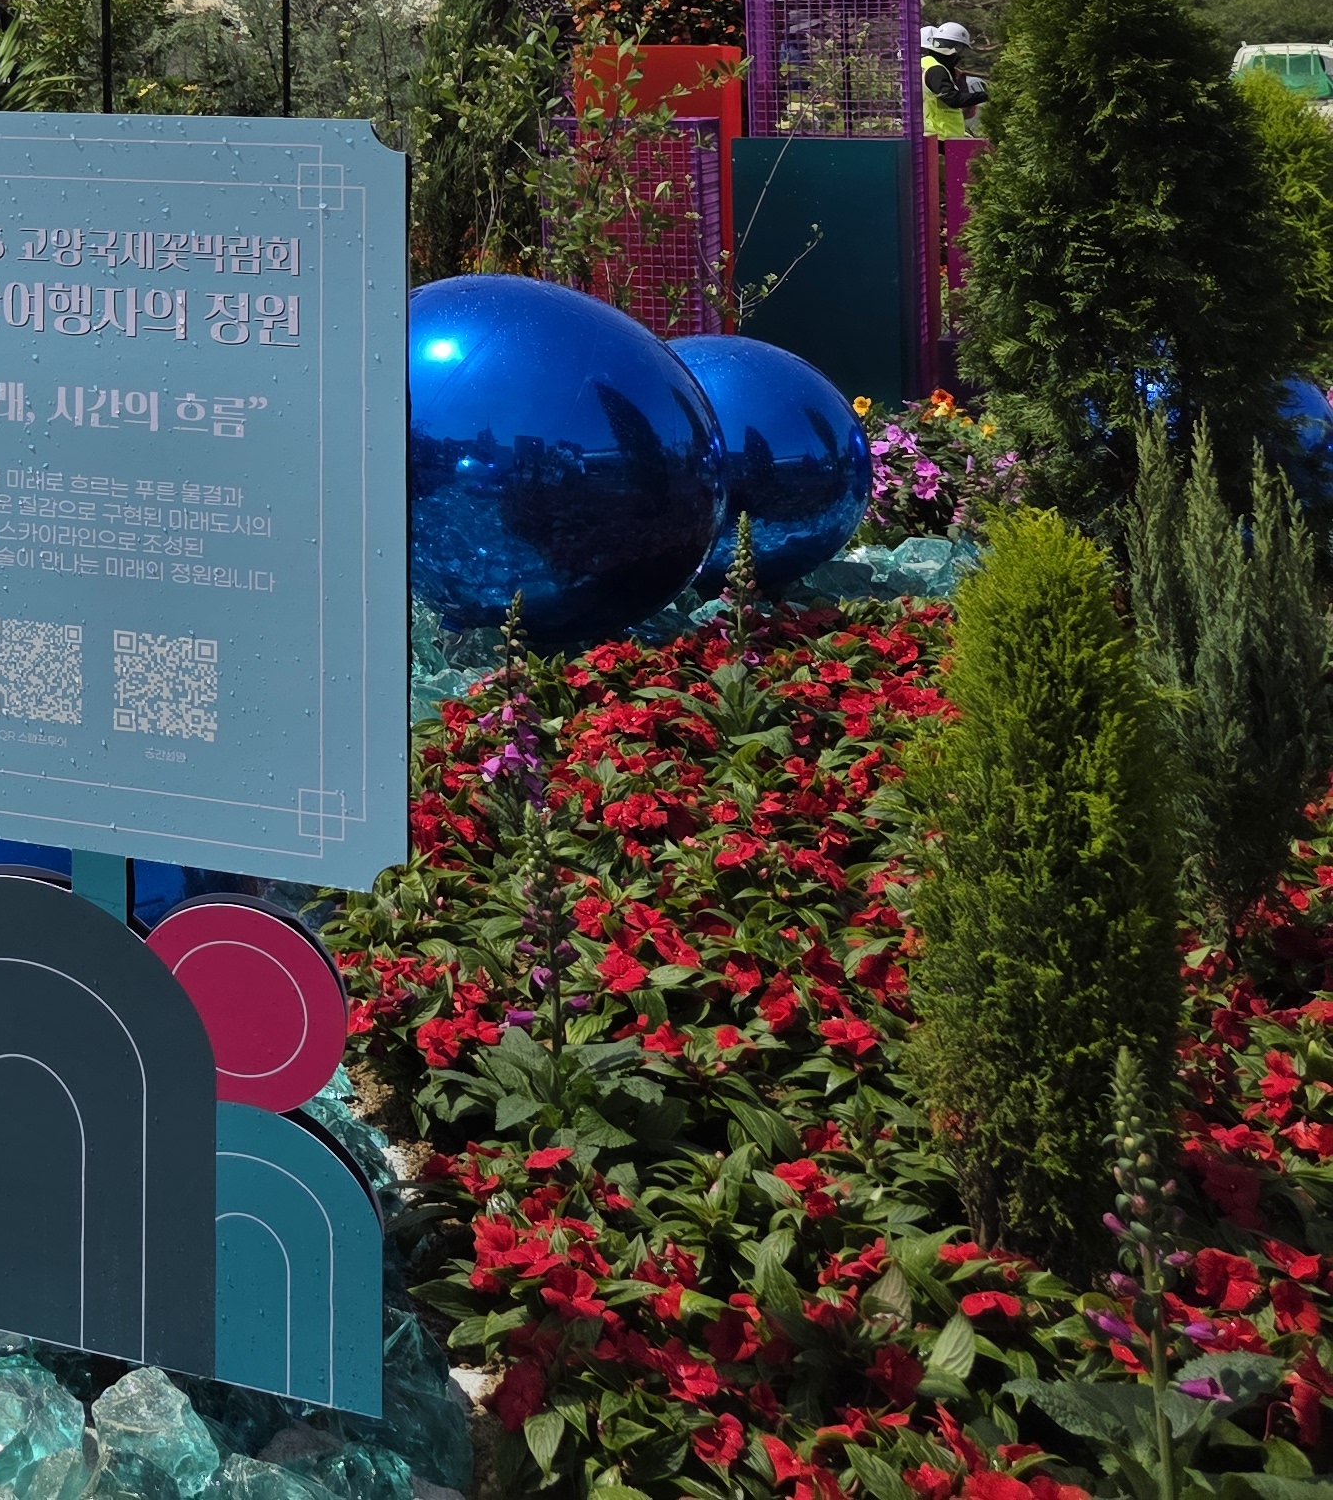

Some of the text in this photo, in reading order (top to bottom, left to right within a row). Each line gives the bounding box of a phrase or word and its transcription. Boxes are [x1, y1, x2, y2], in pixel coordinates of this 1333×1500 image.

[16, 227, 300, 277] 고양국제꽃박람회
[204, 292, 300, 347] 정원
[50, 386, 160, 432] 시간의
[172, 392, 268, 438] 흐름”
[6, 469, 65, 492] 미래로
[69, 473, 129, 498] 흐르는
[134, 479, 176, 502] 푸른
[180, 482, 244, 508] 물결과
[17, 493, 97, 521] 질감으로
[101, 503, 162, 528] 구현된
[142, 533, 204, 558] 조성된
[39, 550, 100, 575] 만나는
[105, 556, 164, 581] 미래의
[170, 562, 276, 593] 정원입니다
